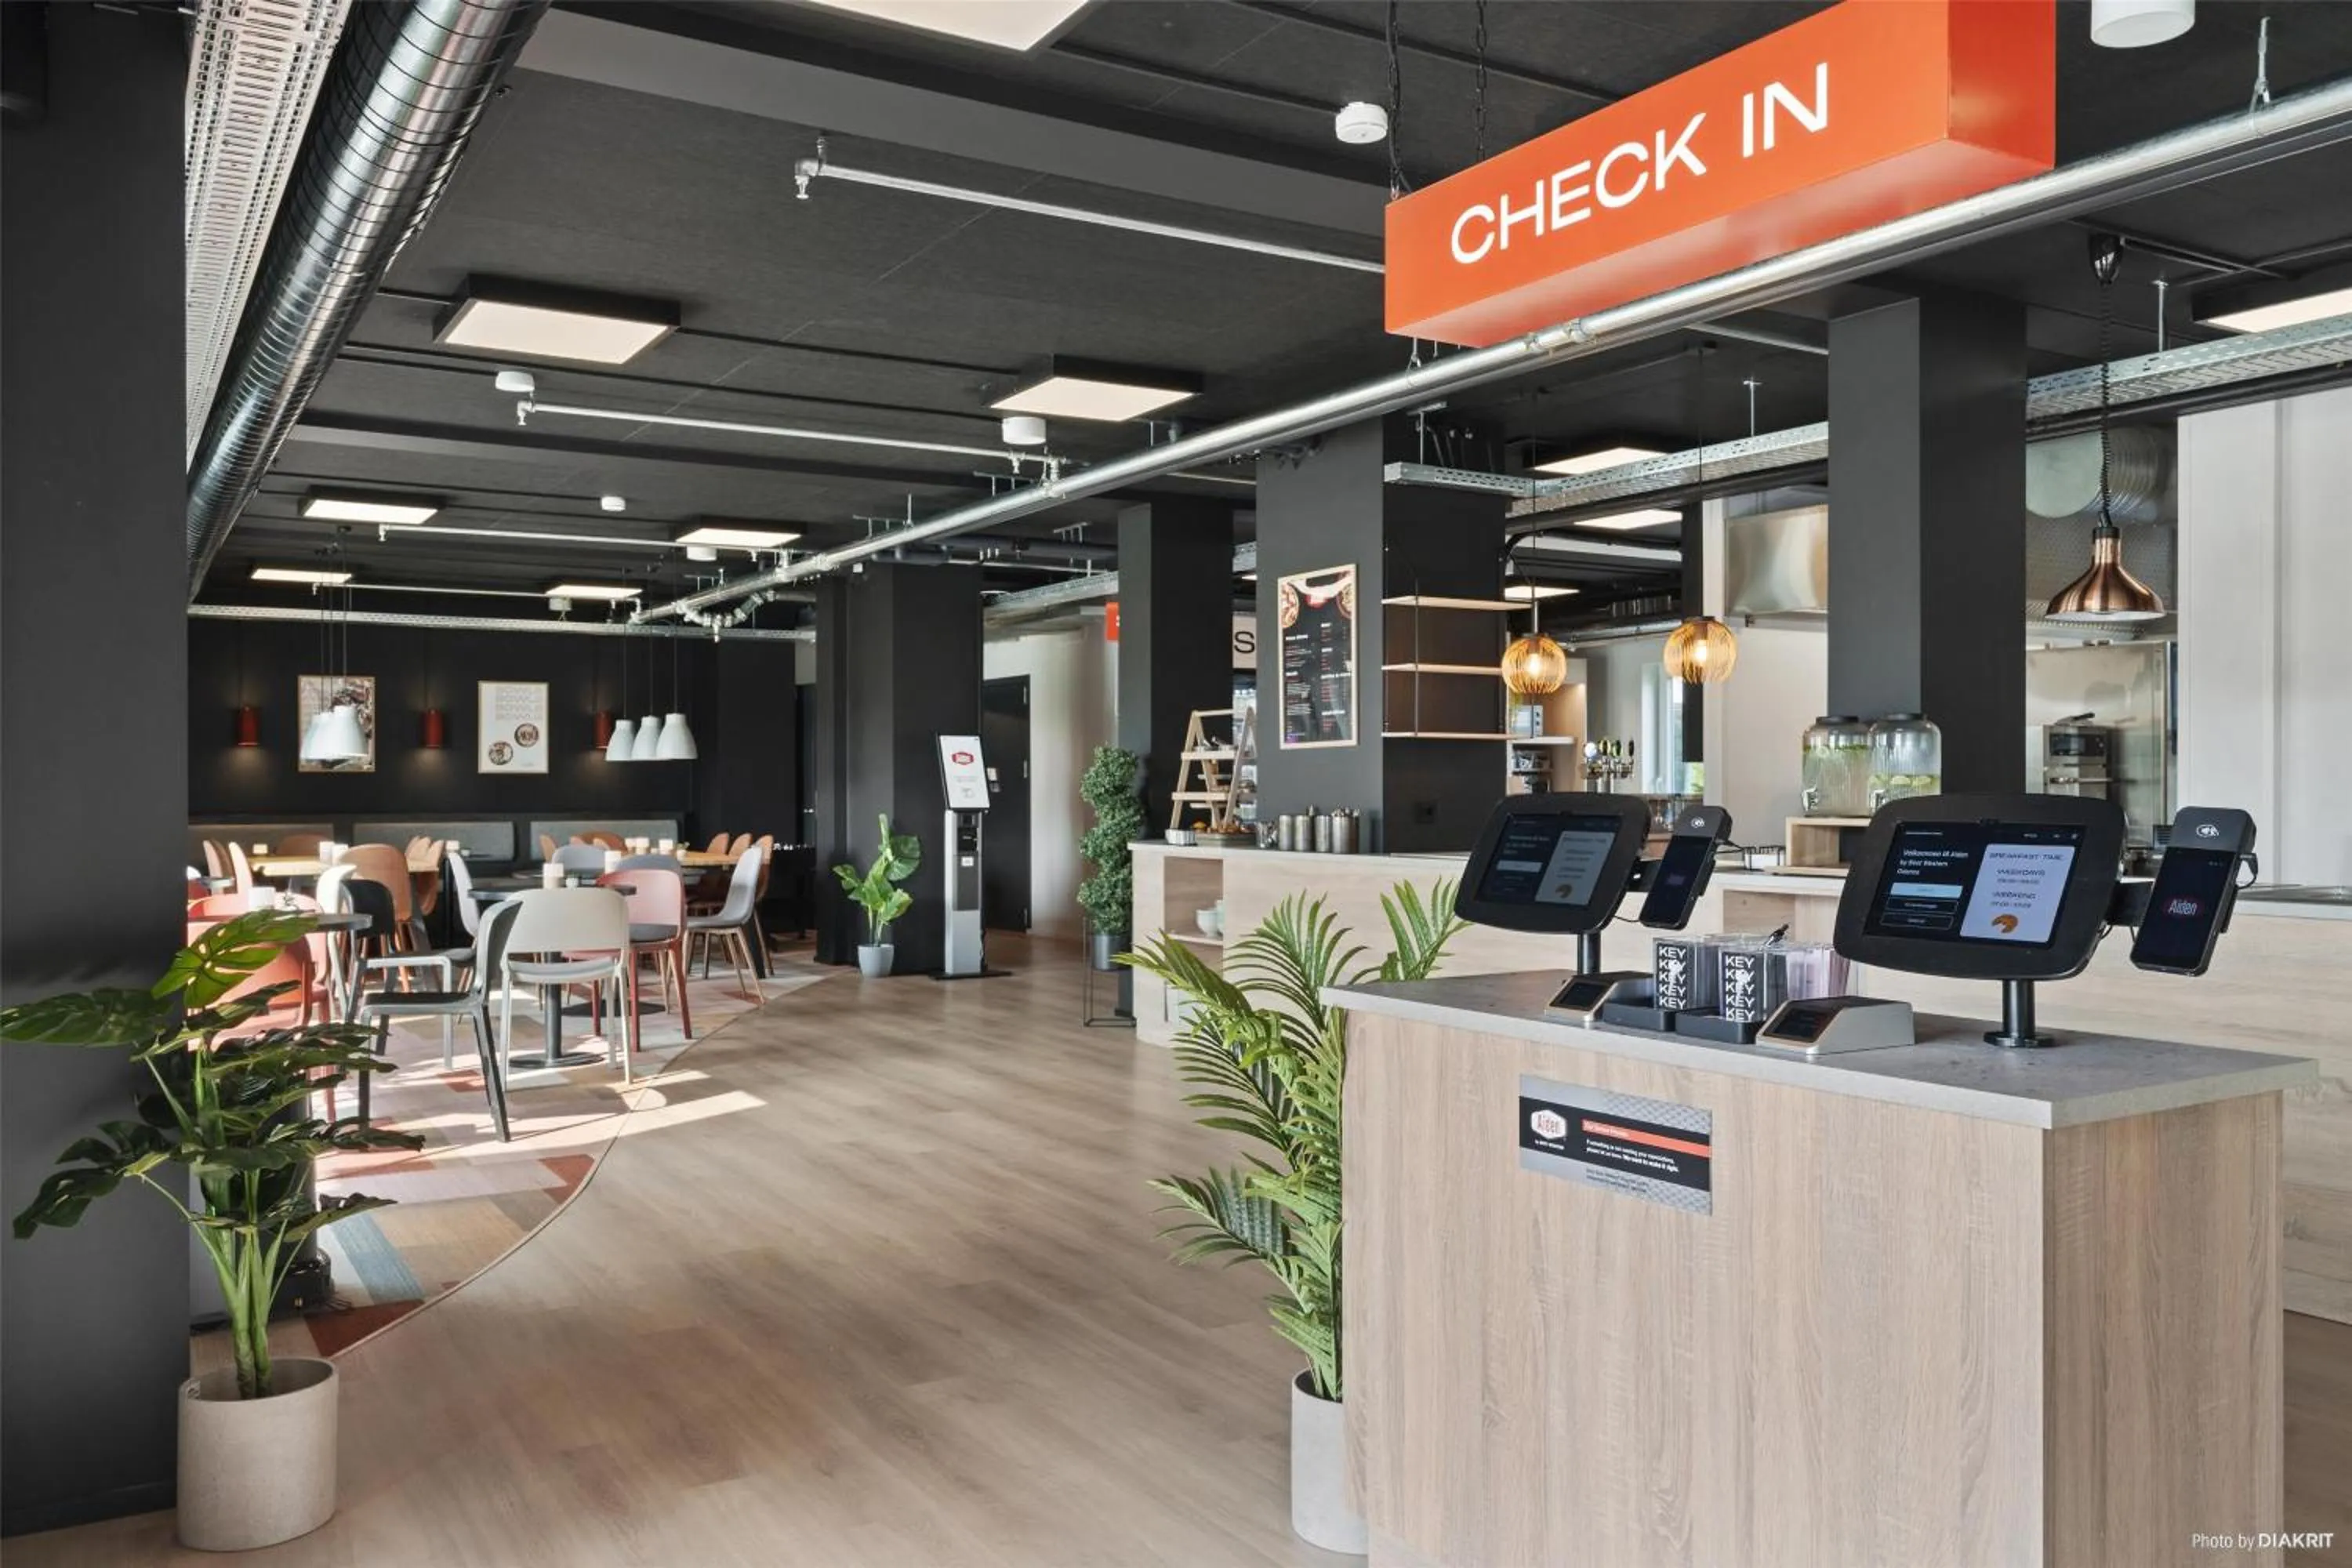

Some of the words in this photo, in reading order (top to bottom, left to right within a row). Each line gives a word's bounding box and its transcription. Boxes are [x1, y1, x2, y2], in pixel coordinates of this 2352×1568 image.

[1450, 111, 1708, 264] CHECK
[1742, 62, 1829, 158] IN
[1234, 631, 1255, 654] S
[2168, 899, 2198, 916] Aiden
[1659, 946, 1686, 959] KEY
[1659, 959, 1686, 971] KY
[1726, 955, 1755, 968] KEY
[1726, 968, 1755, 982] KY
[1659, 984, 1686, 996] KEY
[1659, 996, 1686, 1010] KEY
[1726, 994, 1755, 1007] KEY
[1726, 1007, 1755, 1022] KEY
